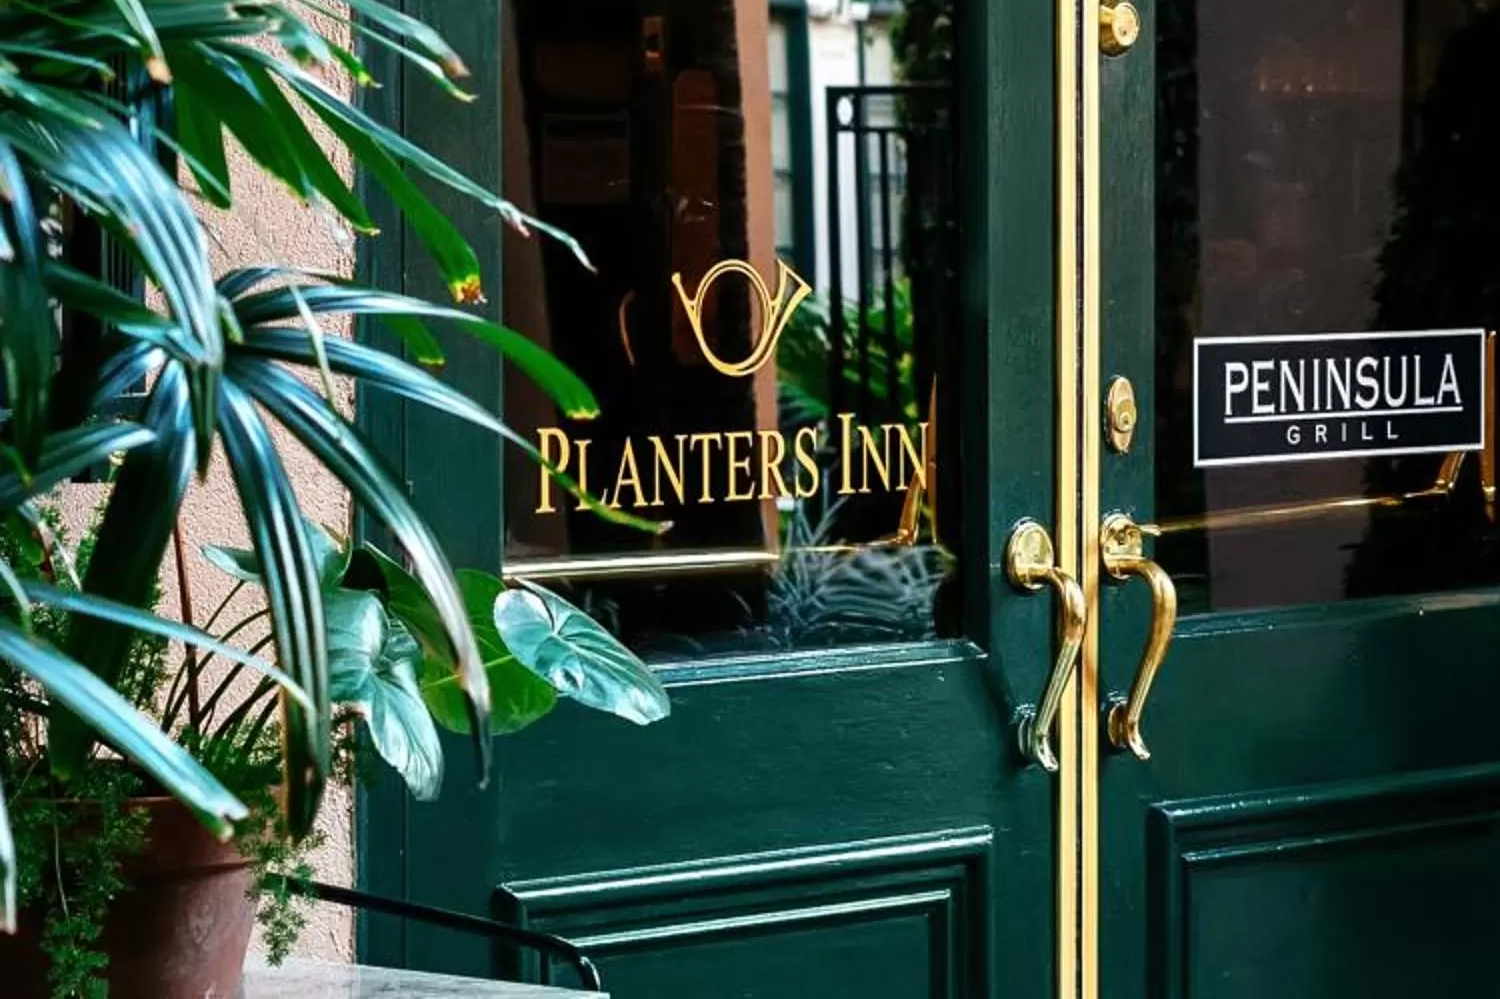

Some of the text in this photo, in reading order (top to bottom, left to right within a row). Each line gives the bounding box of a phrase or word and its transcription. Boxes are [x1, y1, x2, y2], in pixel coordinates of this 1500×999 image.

[1224, 354, 1463, 416] PENINSULA
[534, 412, 930, 514] PLANTERS INN
[1286, 420, 1400, 445] GRILL
